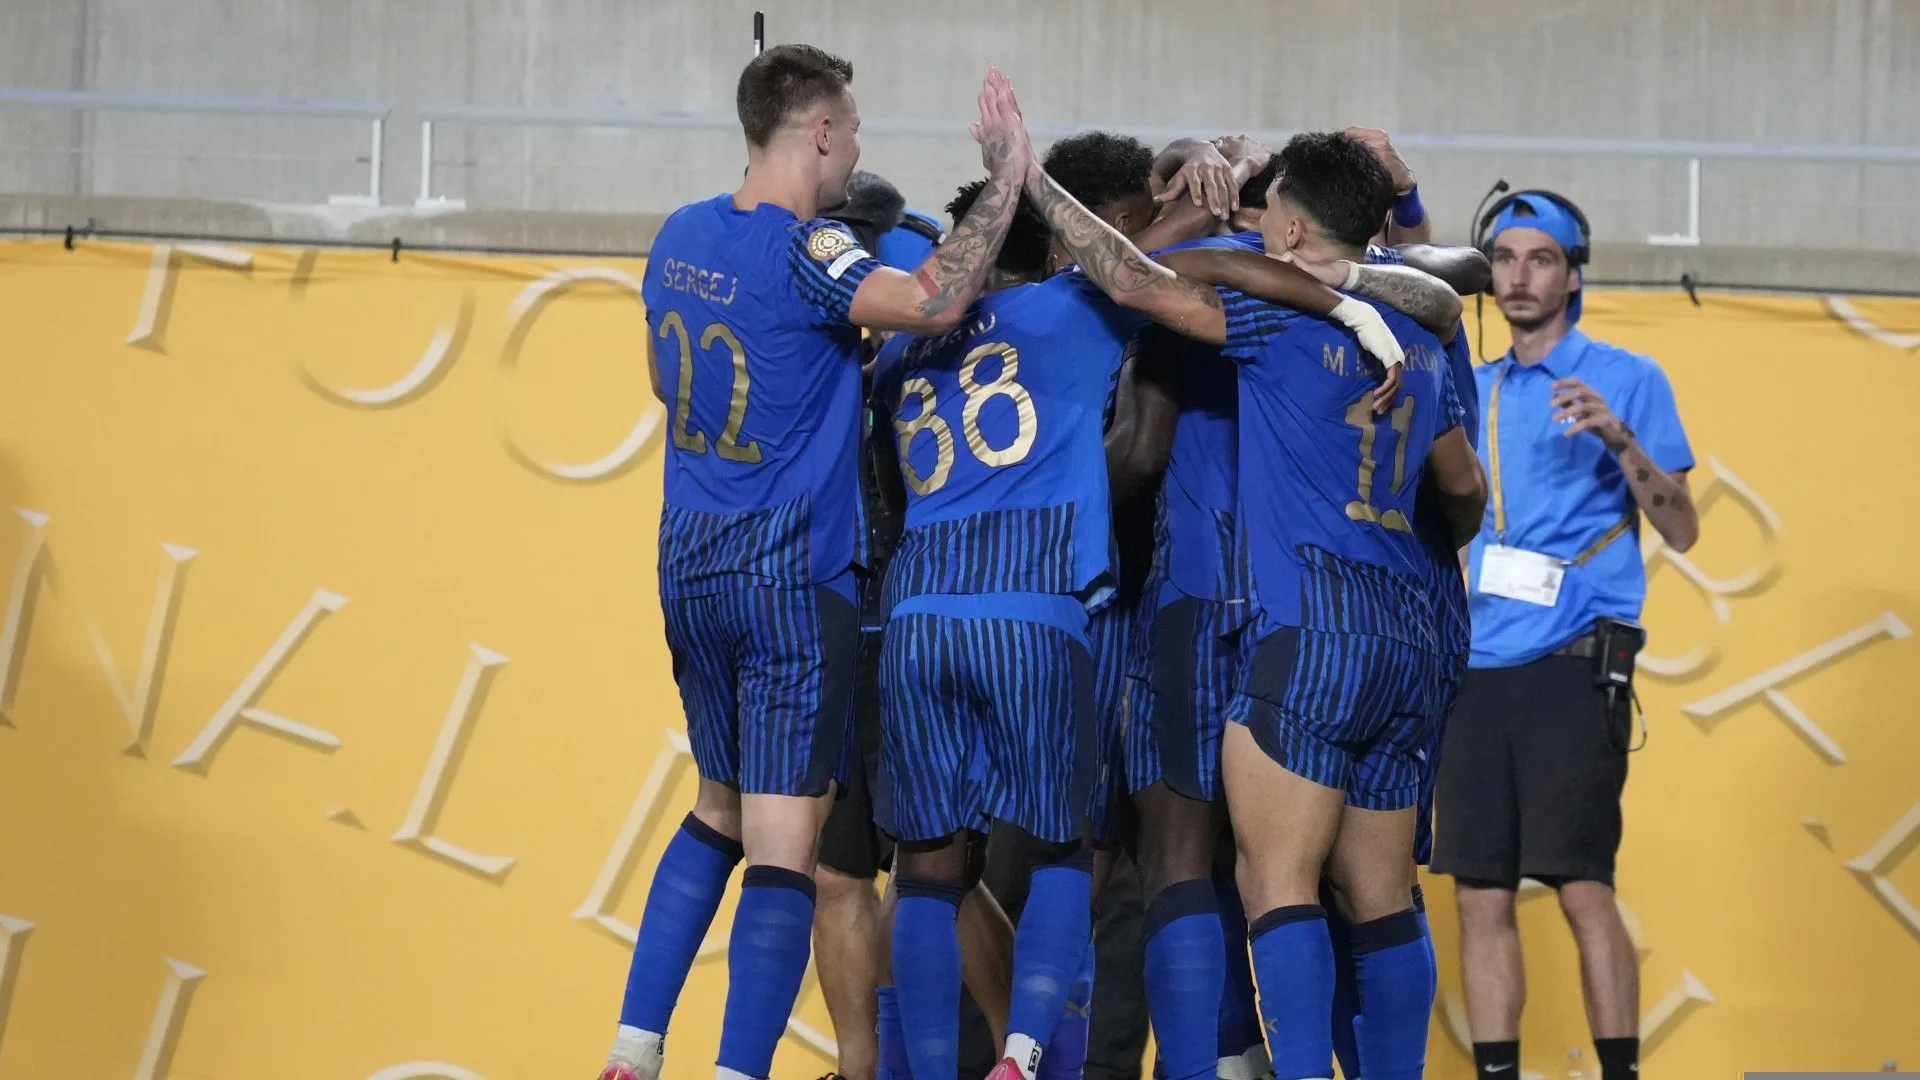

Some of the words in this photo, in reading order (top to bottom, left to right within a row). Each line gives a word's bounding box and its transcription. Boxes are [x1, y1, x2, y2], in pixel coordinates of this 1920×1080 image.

[662, 257, 738, 306] SERGEJ
[658, 310, 764, 465] 22
[894, 341, 1038, 497] 88
[1322, 342, 1351, 377] M.
[1344, 389, 1415, 534] 11
